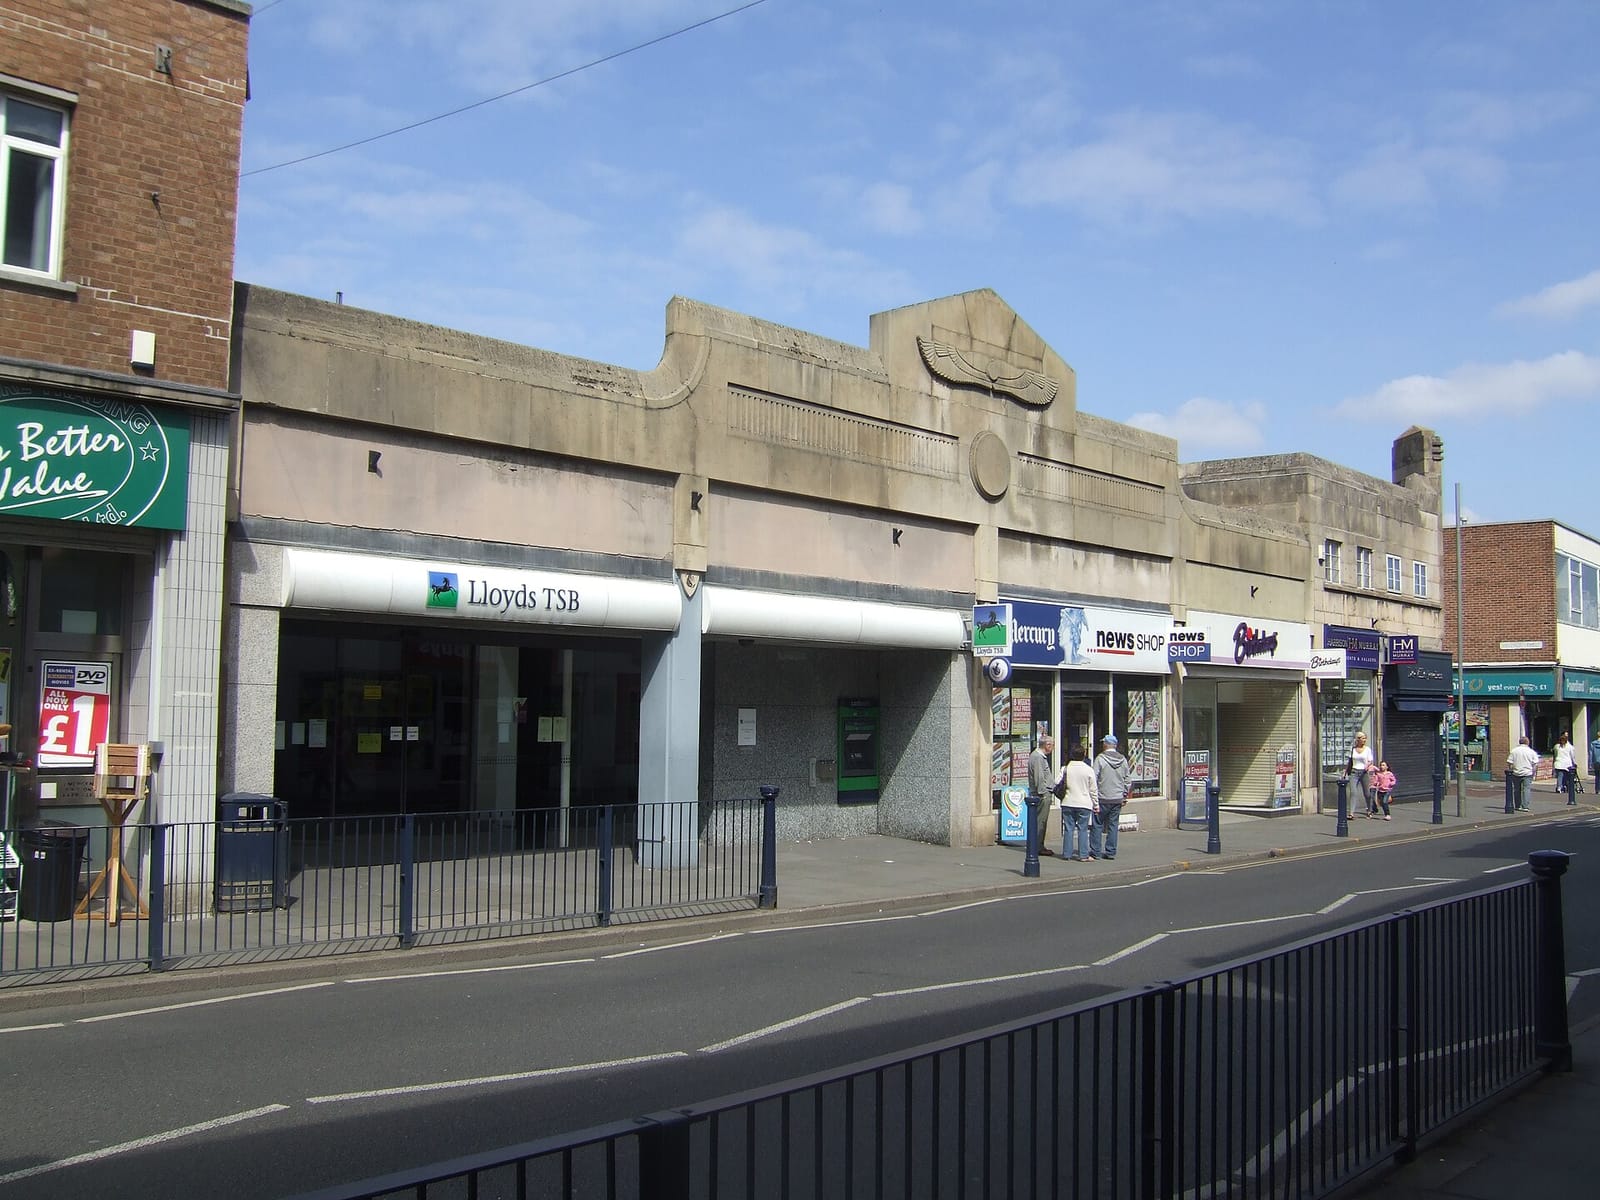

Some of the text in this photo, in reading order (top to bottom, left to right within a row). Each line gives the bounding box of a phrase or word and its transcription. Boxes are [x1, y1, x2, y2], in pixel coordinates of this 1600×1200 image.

[17, 422, 125, 461] Better
[468, 580, 580, 613] Lloyds TSB
[1097, 630, 1165, 651] news SHOP
[1169, 632, 1205, 657] news SHOP
[1393, 639, 1414, 650] HM
[976, 647, 993, 656] Lloyds
[77, 670, 106, 680] DVD
[46, 697, 68, 705] NOW
[43, 703, 69, 711] ONLY
[40, 695, 95, 755] £1
[1187, 753, 1207, 763] TO LET
[1285, 753, 1293, 761] LET
[1007, 819, 1022, 830] Play
[1005, 826, 1024, 836] here!
